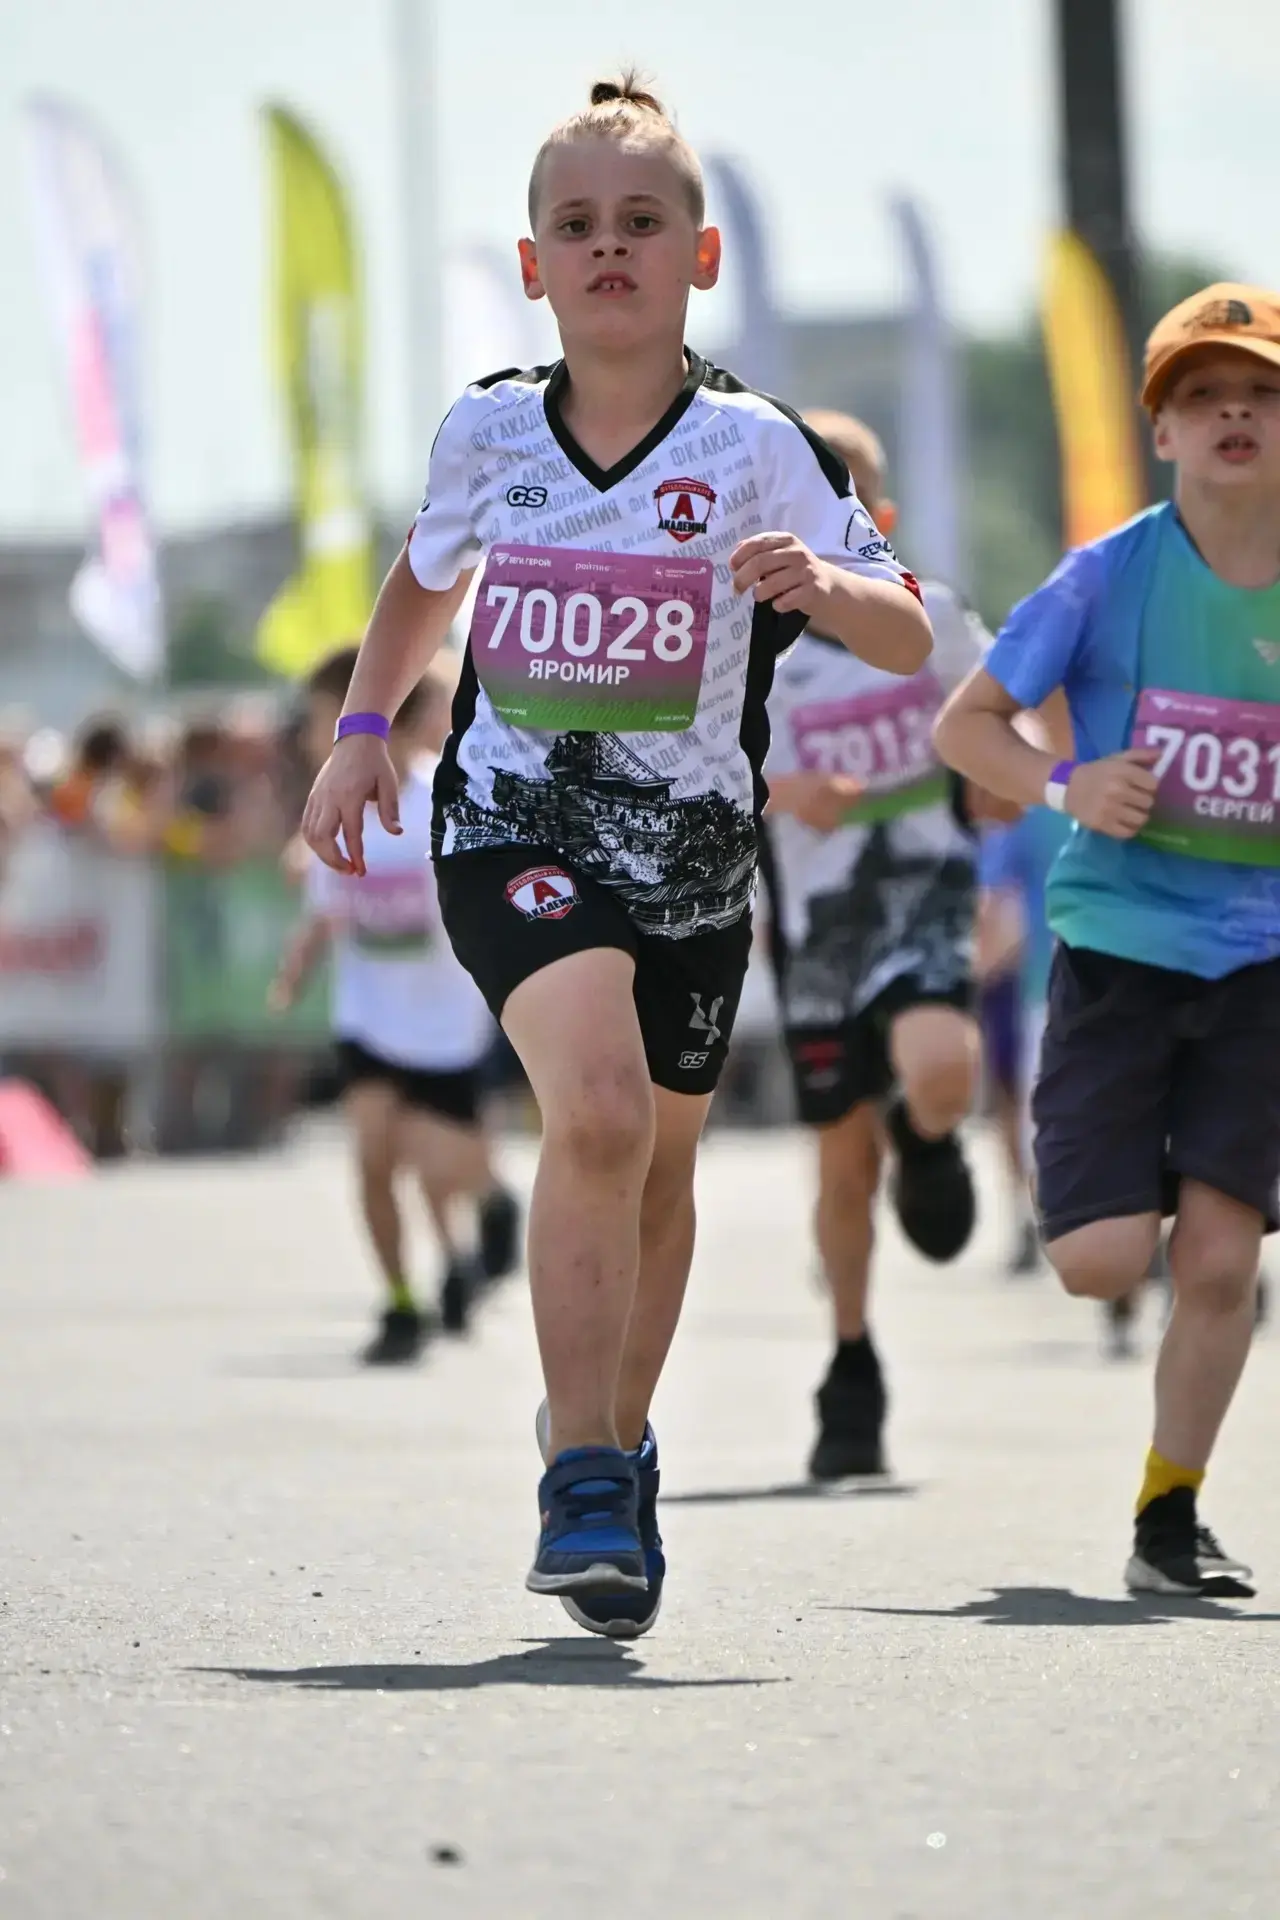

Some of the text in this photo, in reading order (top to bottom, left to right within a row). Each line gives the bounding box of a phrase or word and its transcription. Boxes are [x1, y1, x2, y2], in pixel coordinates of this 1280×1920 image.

[669, 441, 699, 468] ФК
[507, 486, 548, 507] GS
[536, 498, 622, 545] АКАДЕМИЯ
[658, 519, 707, 534] АКАДЕМИЯ
[486, 585, 695, 662] 70028
[528, 659, 631, 686] ЯРОМИР
[1146, 724, 1280, 801] 7031
[1194, 795, 1275, 823] СЕРГЕЙ
[526, 894, 583, 922] АКАДЕМИЯ
[678, 1050, 709, 1069] GS
